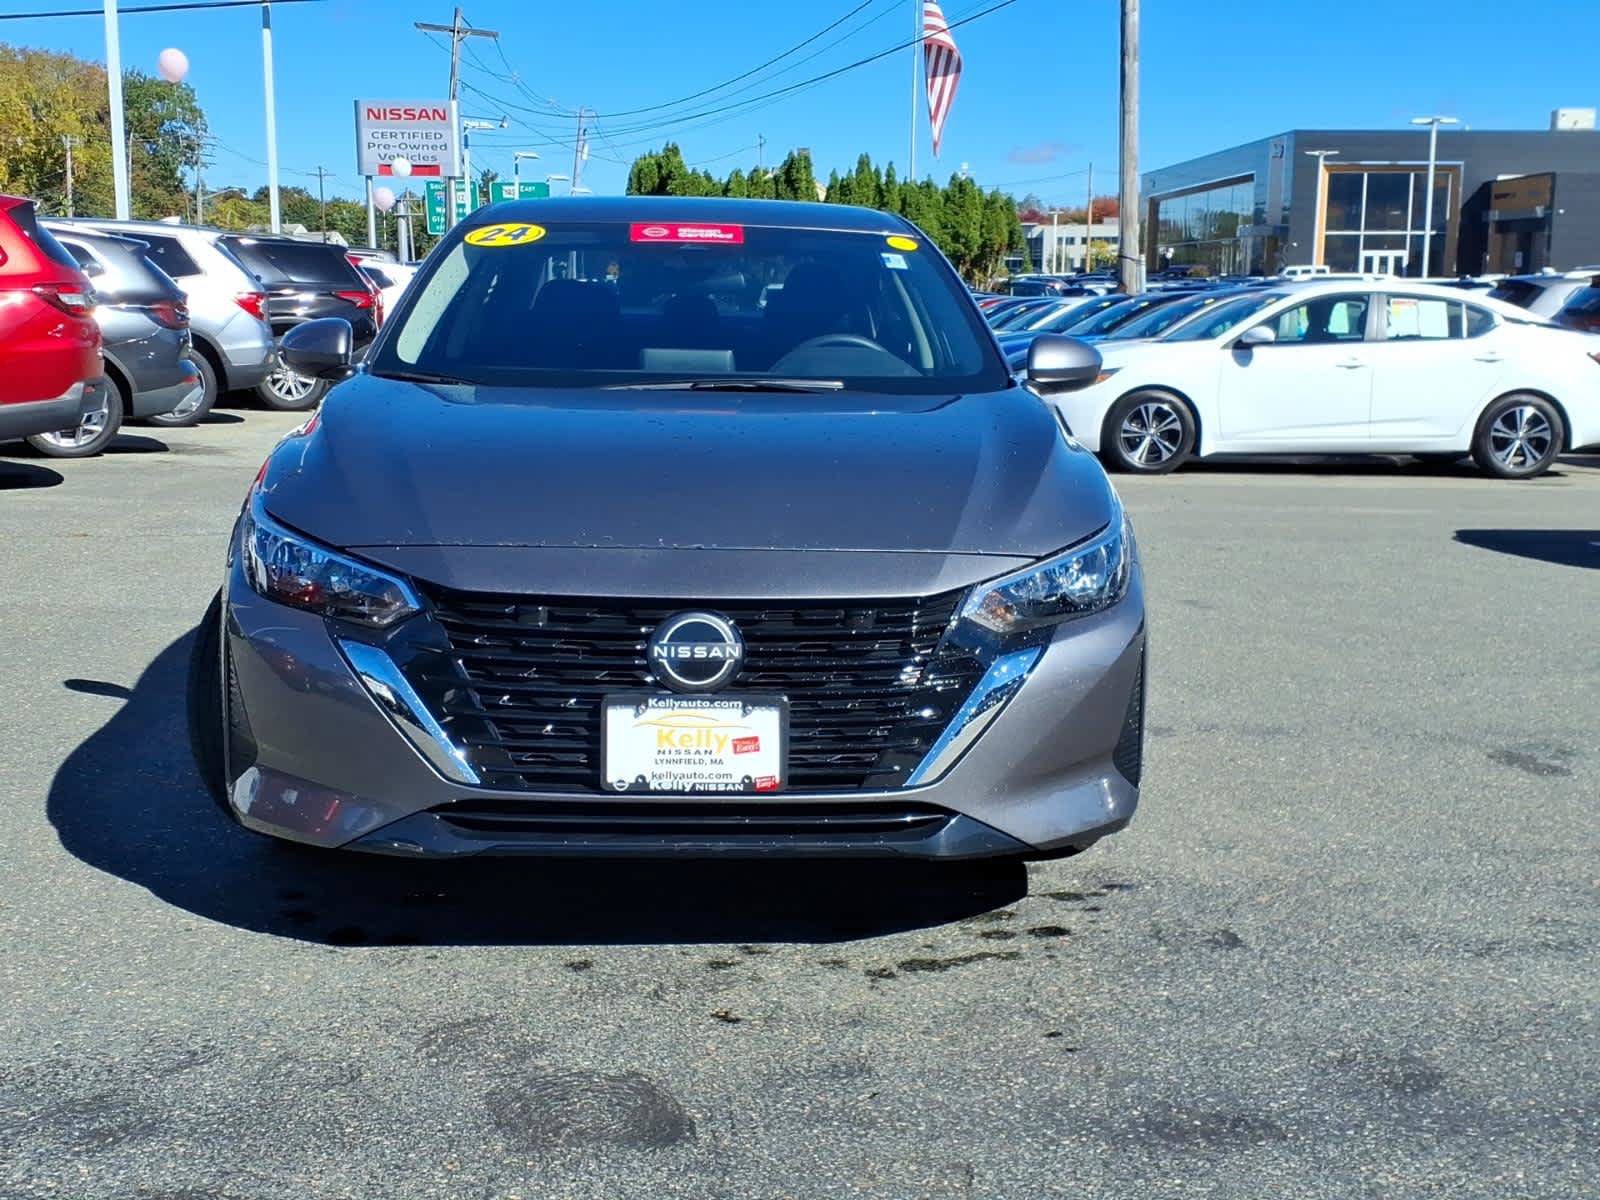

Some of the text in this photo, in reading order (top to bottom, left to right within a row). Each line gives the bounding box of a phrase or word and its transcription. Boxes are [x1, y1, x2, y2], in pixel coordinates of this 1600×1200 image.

[366, 108, 447, 121] NISSAN
[371, 131, 443, 141] CERTIFIED
[367, 142, 448, 151] Pre-Owned
[475, 227, 530, 242] 24
[653, 646, 740, 659] NISSAN
[648, 698, 743, 711] Kellyauto.com
[656, 728, 729, 754] Kelly
[654, 758, 724, 767] LYNNFIELD, MA
[651, 770, 733, 781] kellyauto.com
[649, 780, 744, 792] Kelly NISSAN
